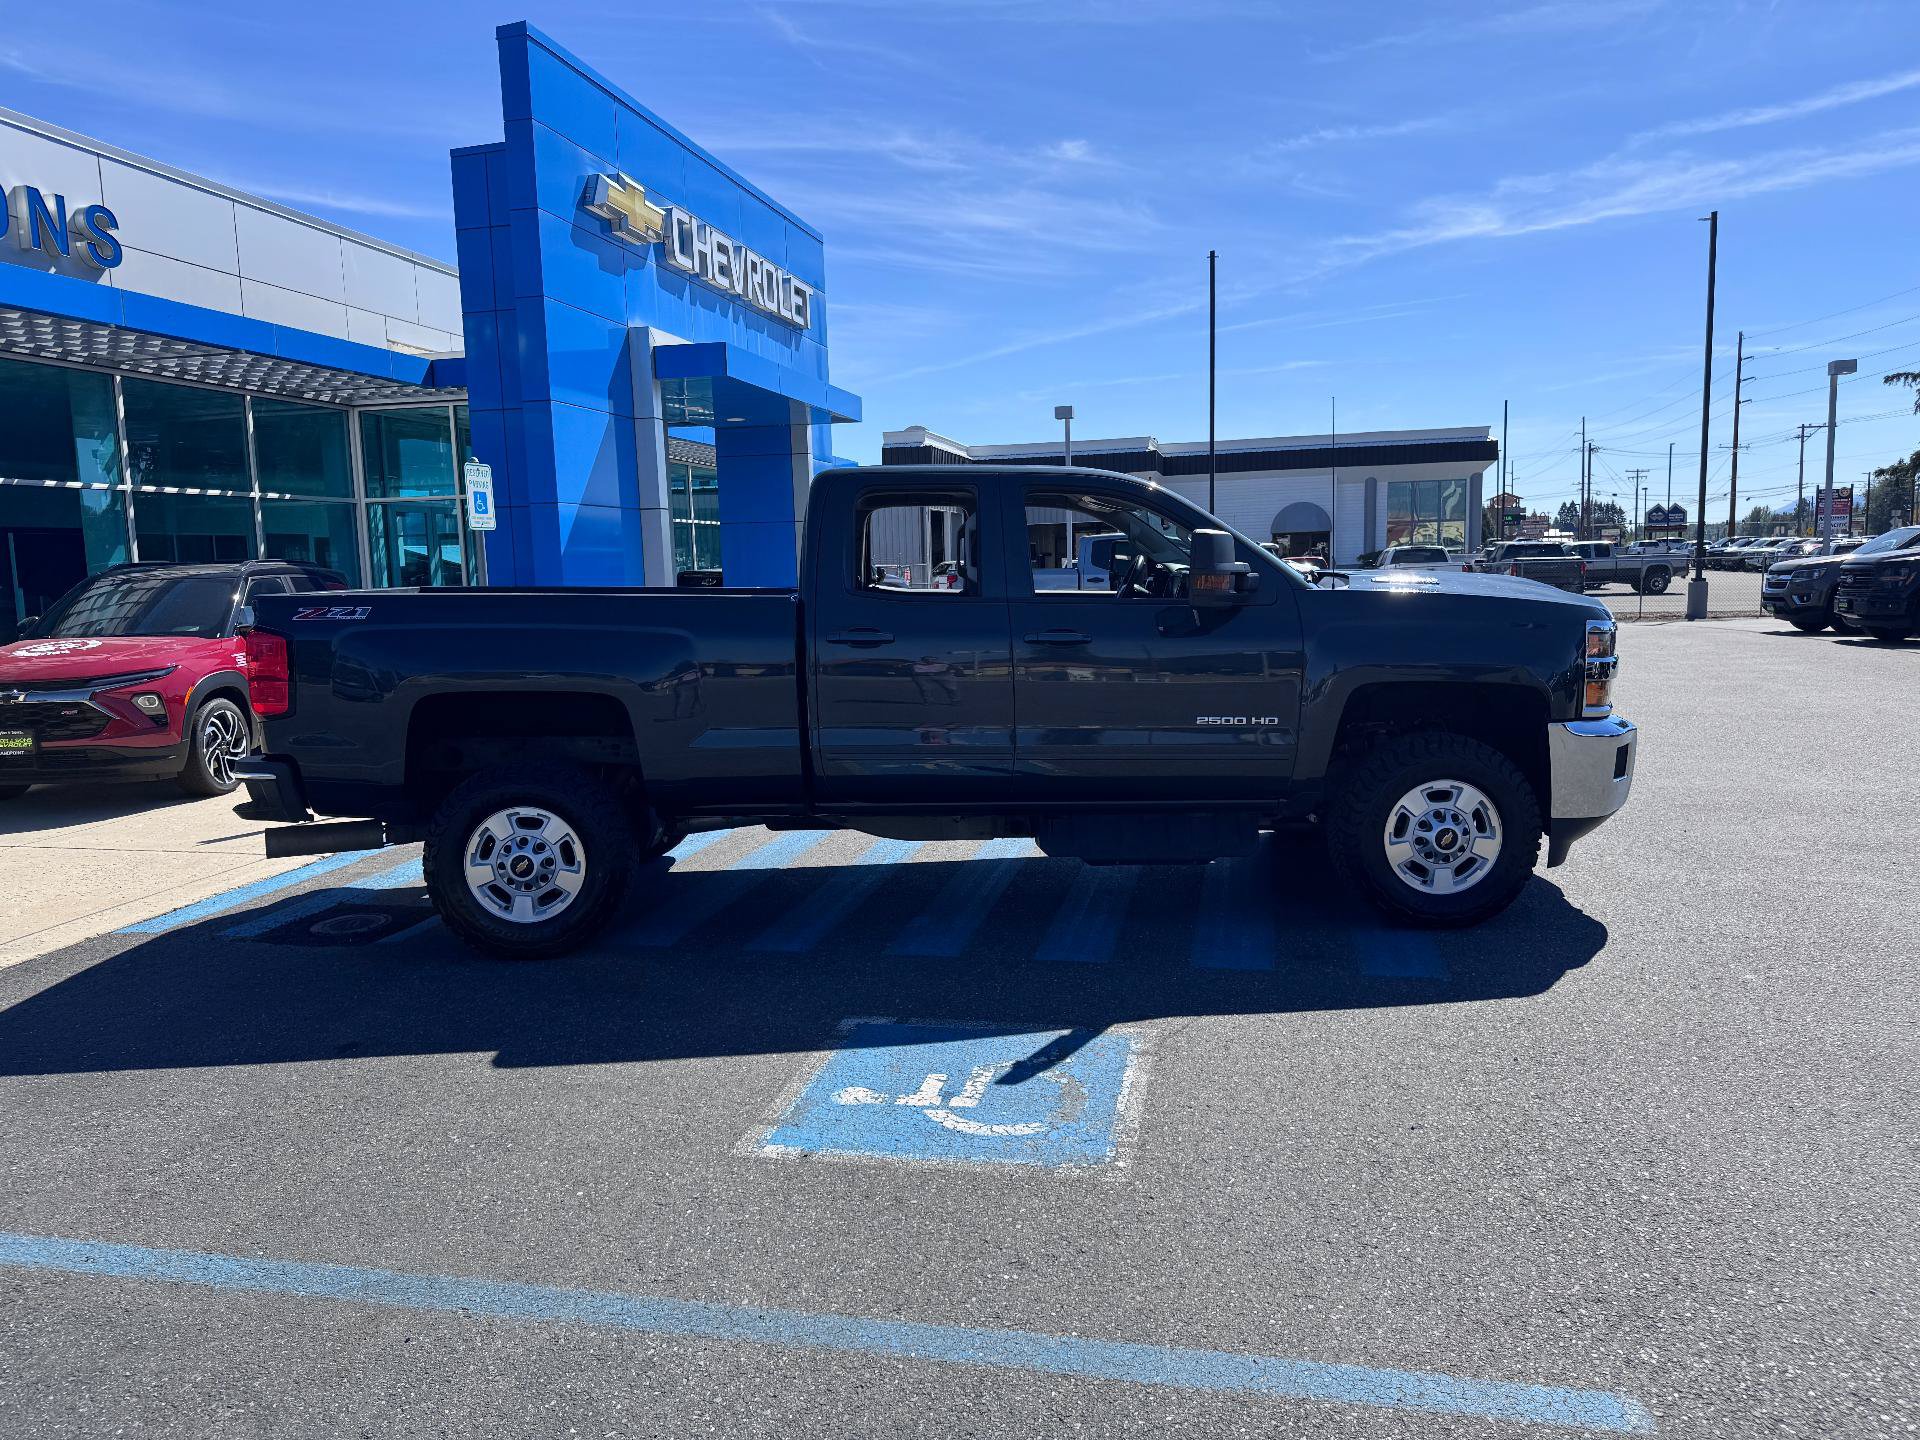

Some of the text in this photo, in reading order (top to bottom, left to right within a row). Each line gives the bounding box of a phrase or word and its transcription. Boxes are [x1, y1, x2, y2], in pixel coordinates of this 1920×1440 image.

[0, 183, 122, 268] NS
[667, 206, 814, 330] CHEVROLET
[292, 606, 372, 620] Z71
[1196, 716, 1279, 725] 2500 HD
